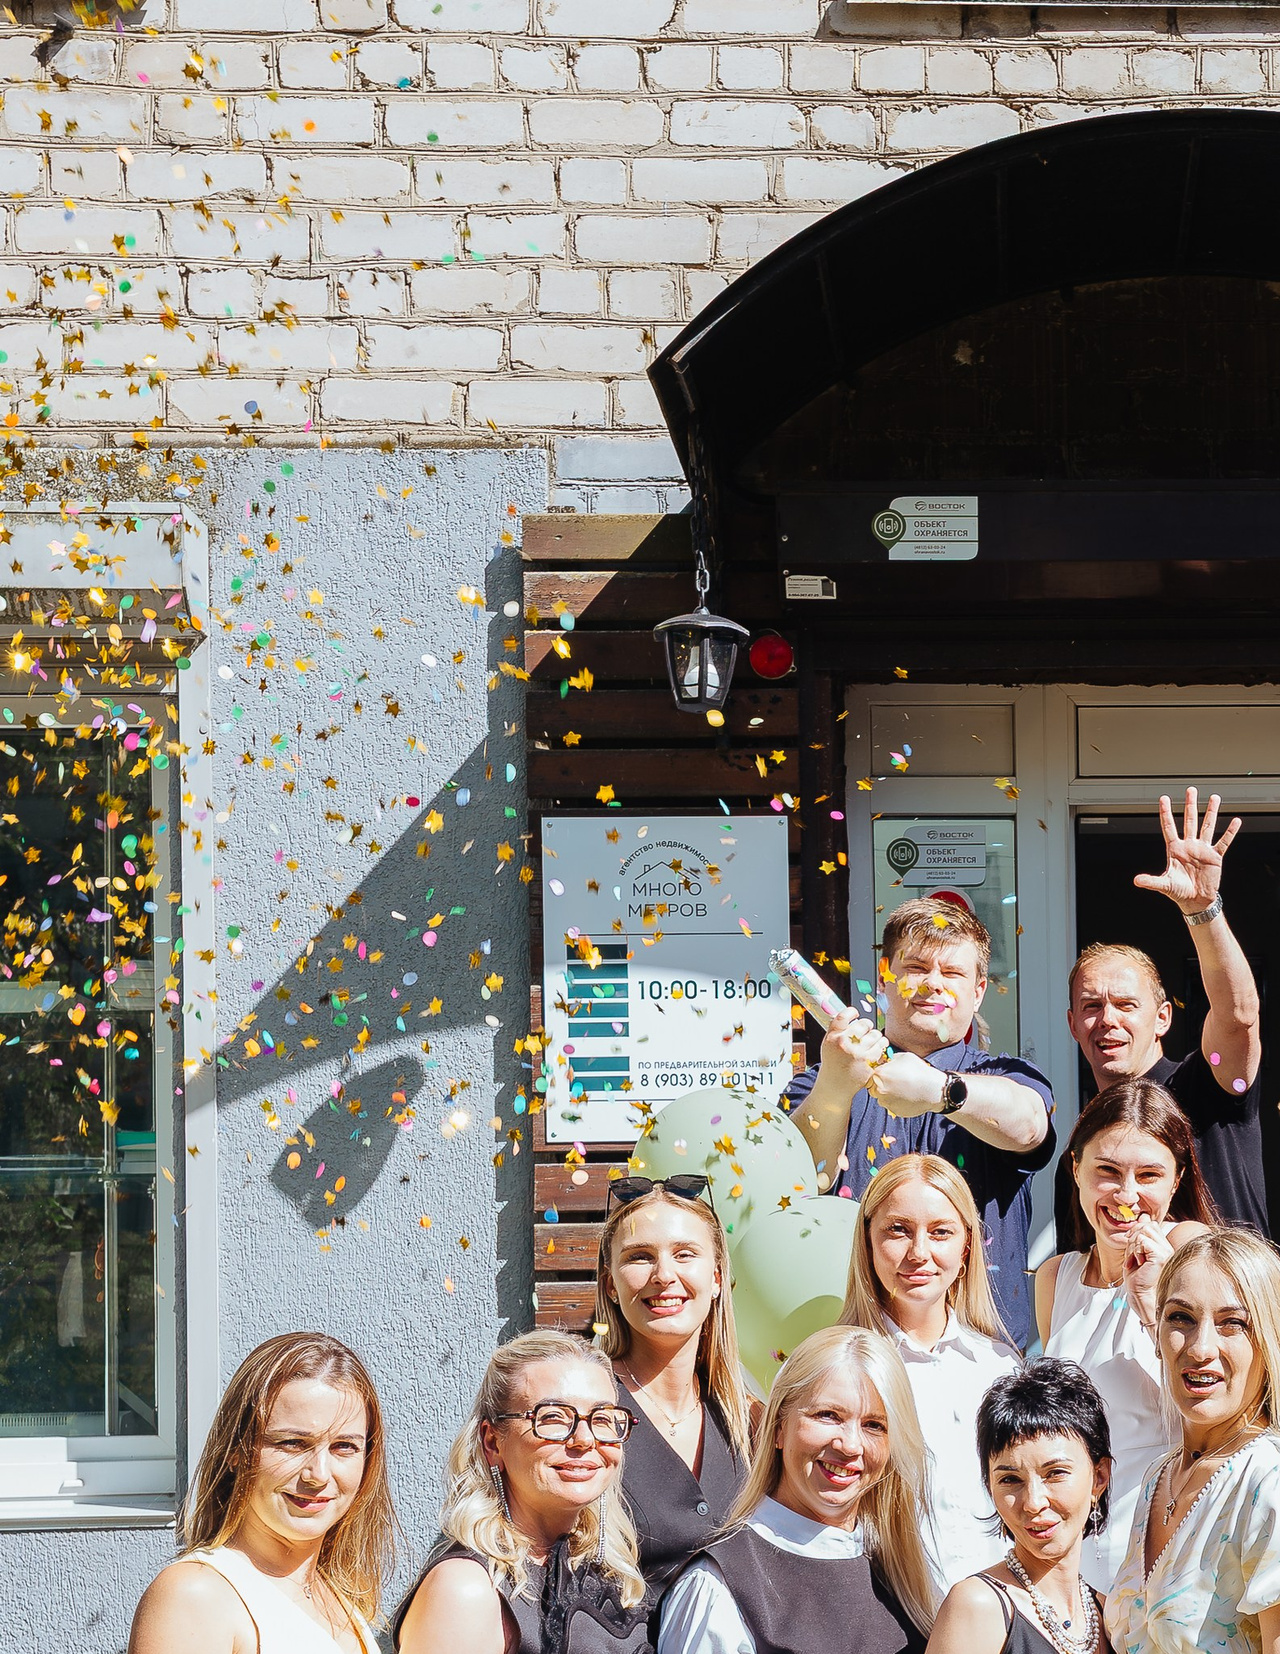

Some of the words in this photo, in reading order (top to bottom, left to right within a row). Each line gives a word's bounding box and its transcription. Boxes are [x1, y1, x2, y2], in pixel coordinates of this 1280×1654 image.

[914, 520, 947, 528] ОБЪЕКТ
[914, 529, 968, 537] ОХРАНЯЕТСЯ
[926, 848, 957, 856] ОБЪЕКТ
[618, 843, 654, 876] агентство
[656, 840, 714, 871] недвижимос
[926, 856, 977, 865] ОХРАНЯЕТСЯ
[632, 882, 702, 897] МНОГО
[628, 903, 708, 918] МЕРОВ
[638, 1061, 652, 1070] ПО
[654, 1060, 738, 1070] ПРЕДВАРИТЕЛЬНОЙ
[640, 1073, 650, 1087] 8
[655, 1073, 694, 1089] (903)
